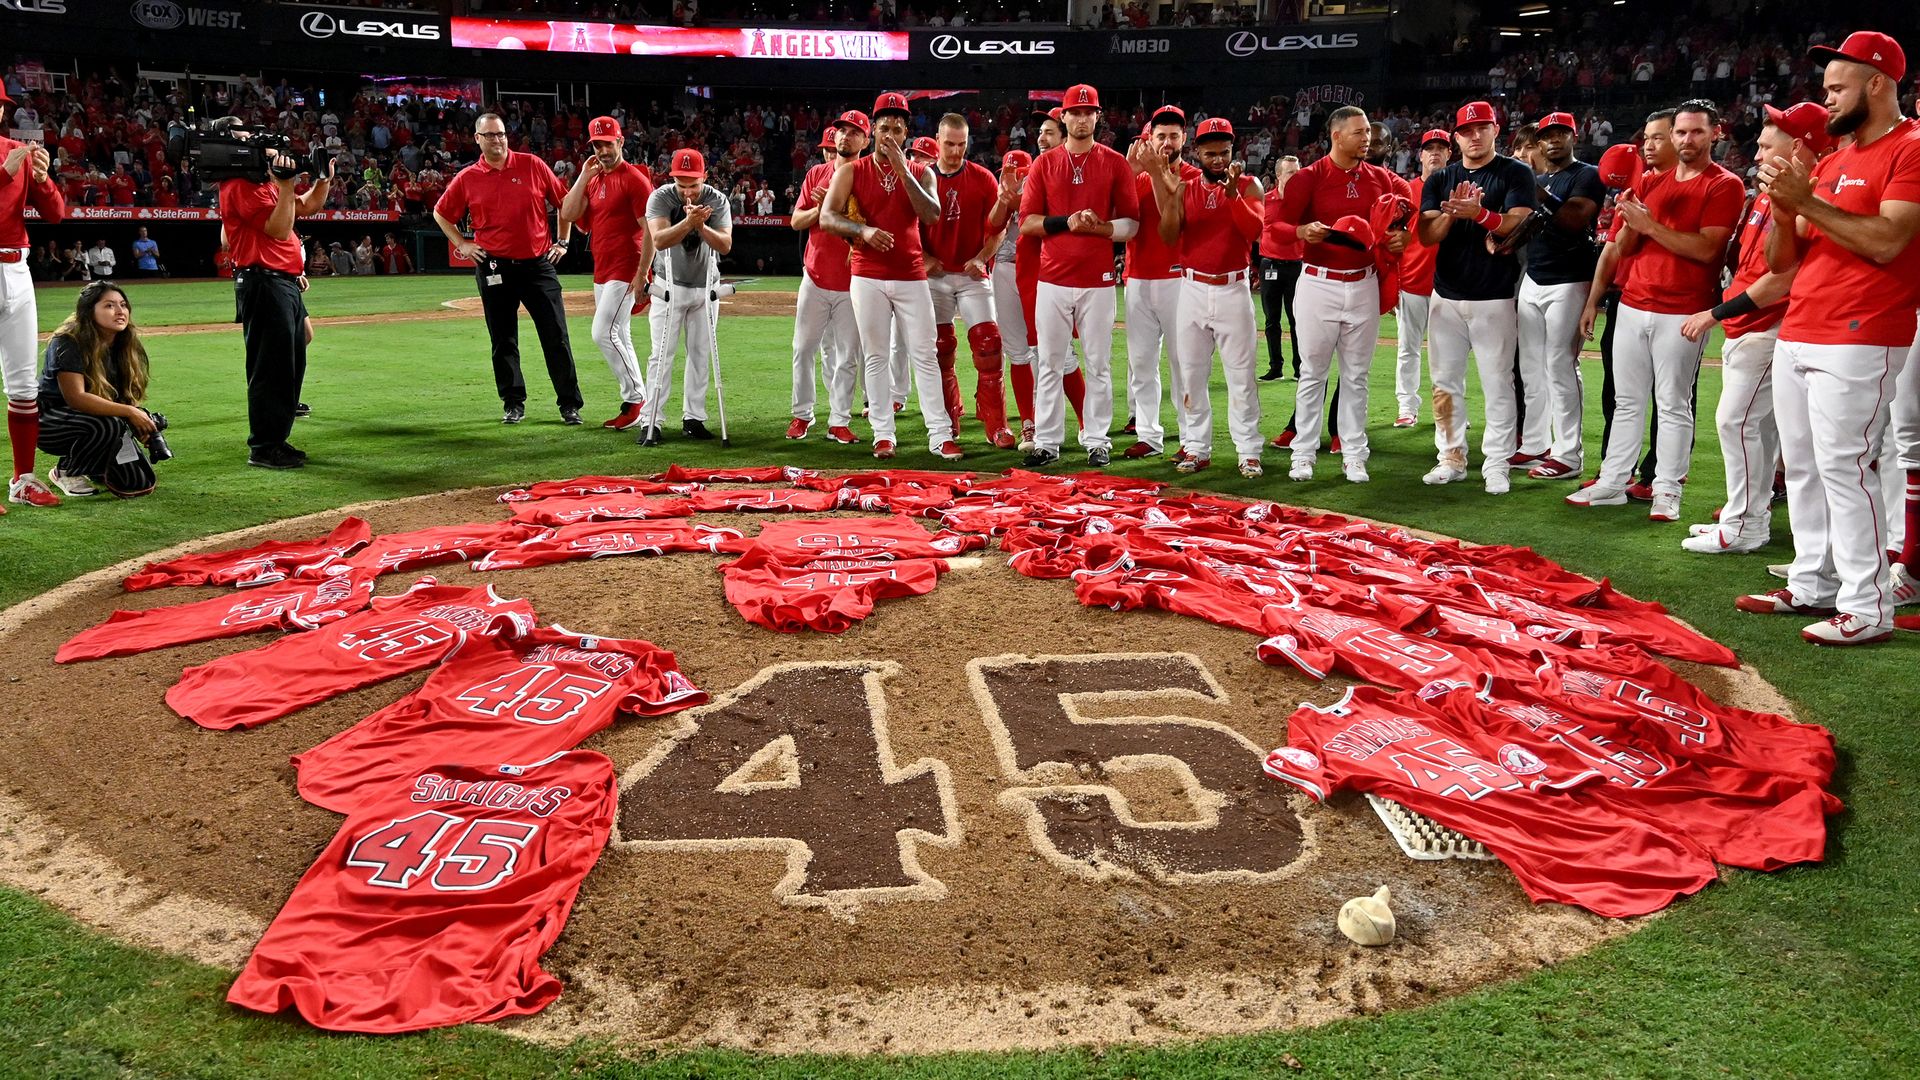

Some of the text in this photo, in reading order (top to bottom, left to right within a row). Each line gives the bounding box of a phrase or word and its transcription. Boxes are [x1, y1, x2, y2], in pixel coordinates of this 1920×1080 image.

[142, 3, 172, 18] FOX
[187, 7, 242, 29] WEST
[339, 19, 440, 40] LEXUS
[751, 28, 884, 58] ANGELS WIN
[963, 40, 1055, 56] LEXUS
[1261, 32, 1359, 51] LEXUS
[1078, 87, 1088, 102] A
[1291, 84, 1365, 115] ANGELS
[1466, 105, 1477, 120] A
[1549, 112, 1558, 124] A
[594, 121, 603, 134] A
[1209, 120, 1219, 132] A
[681, 154, 691, 168] A
[1346, 181, 1358, 198] A
[1206, 192, 1217, 209] A
[337, 619, 453, 662] 45
[1345, 627, 1453, 674] 45
[456, 664, 613, 725] 45
[1321, 716, 1432, 761] SKAGGS
[610, 650, 1320, 905] 45
[1388, 738, 1525, 801] 45
[410, 773, 571, 818] SKAGGS
[346, 809, 540, 891] 45
